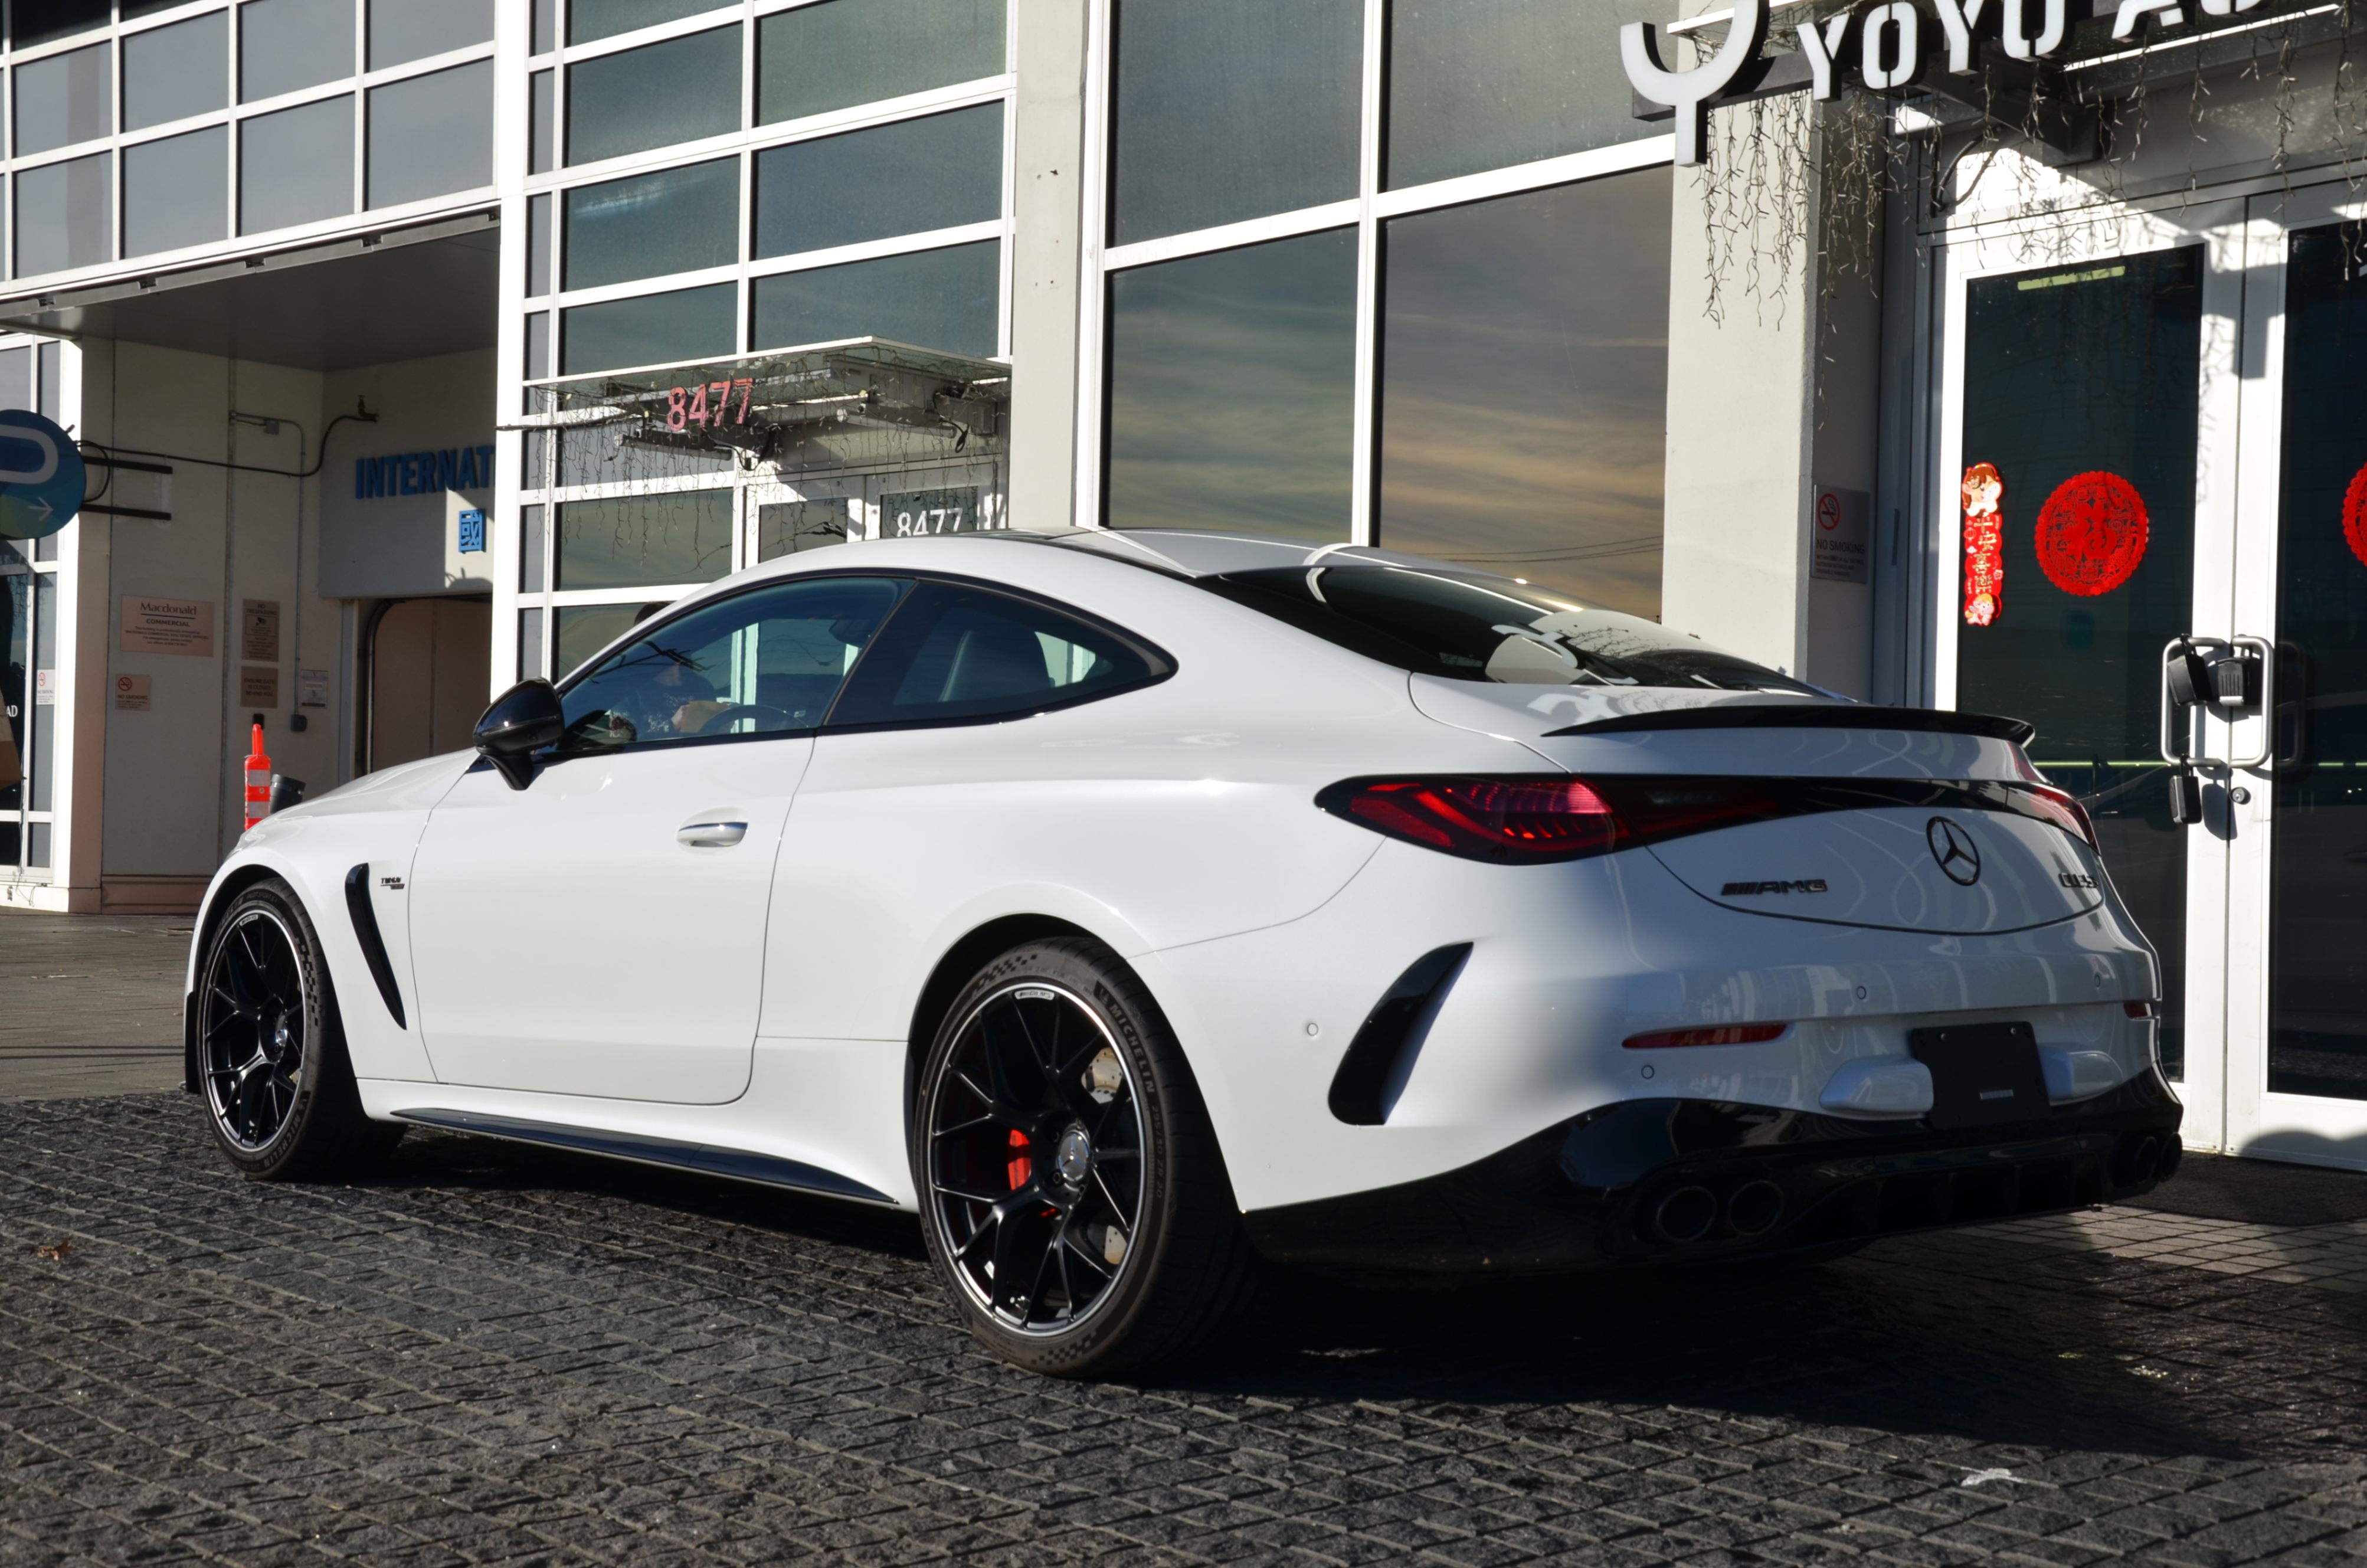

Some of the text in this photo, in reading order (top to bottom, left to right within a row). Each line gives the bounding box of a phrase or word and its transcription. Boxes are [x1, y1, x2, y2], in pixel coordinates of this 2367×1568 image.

[667, 378, 754, 431] 8477
[355, 445, 496, 499] INTERNAT
[459, 508, 485, 554] 國
[897, 508, 964, 537] 8477
[1817, 539, 1865, 554] NO SMOKING
[140, 603, 197, 615] Macdonald
[146, 618, 190, 627] COMMERCIAL
[1755, 879, 1828, 895] AMG
[1109, 1004, 1155, 1094] MICHELIN
